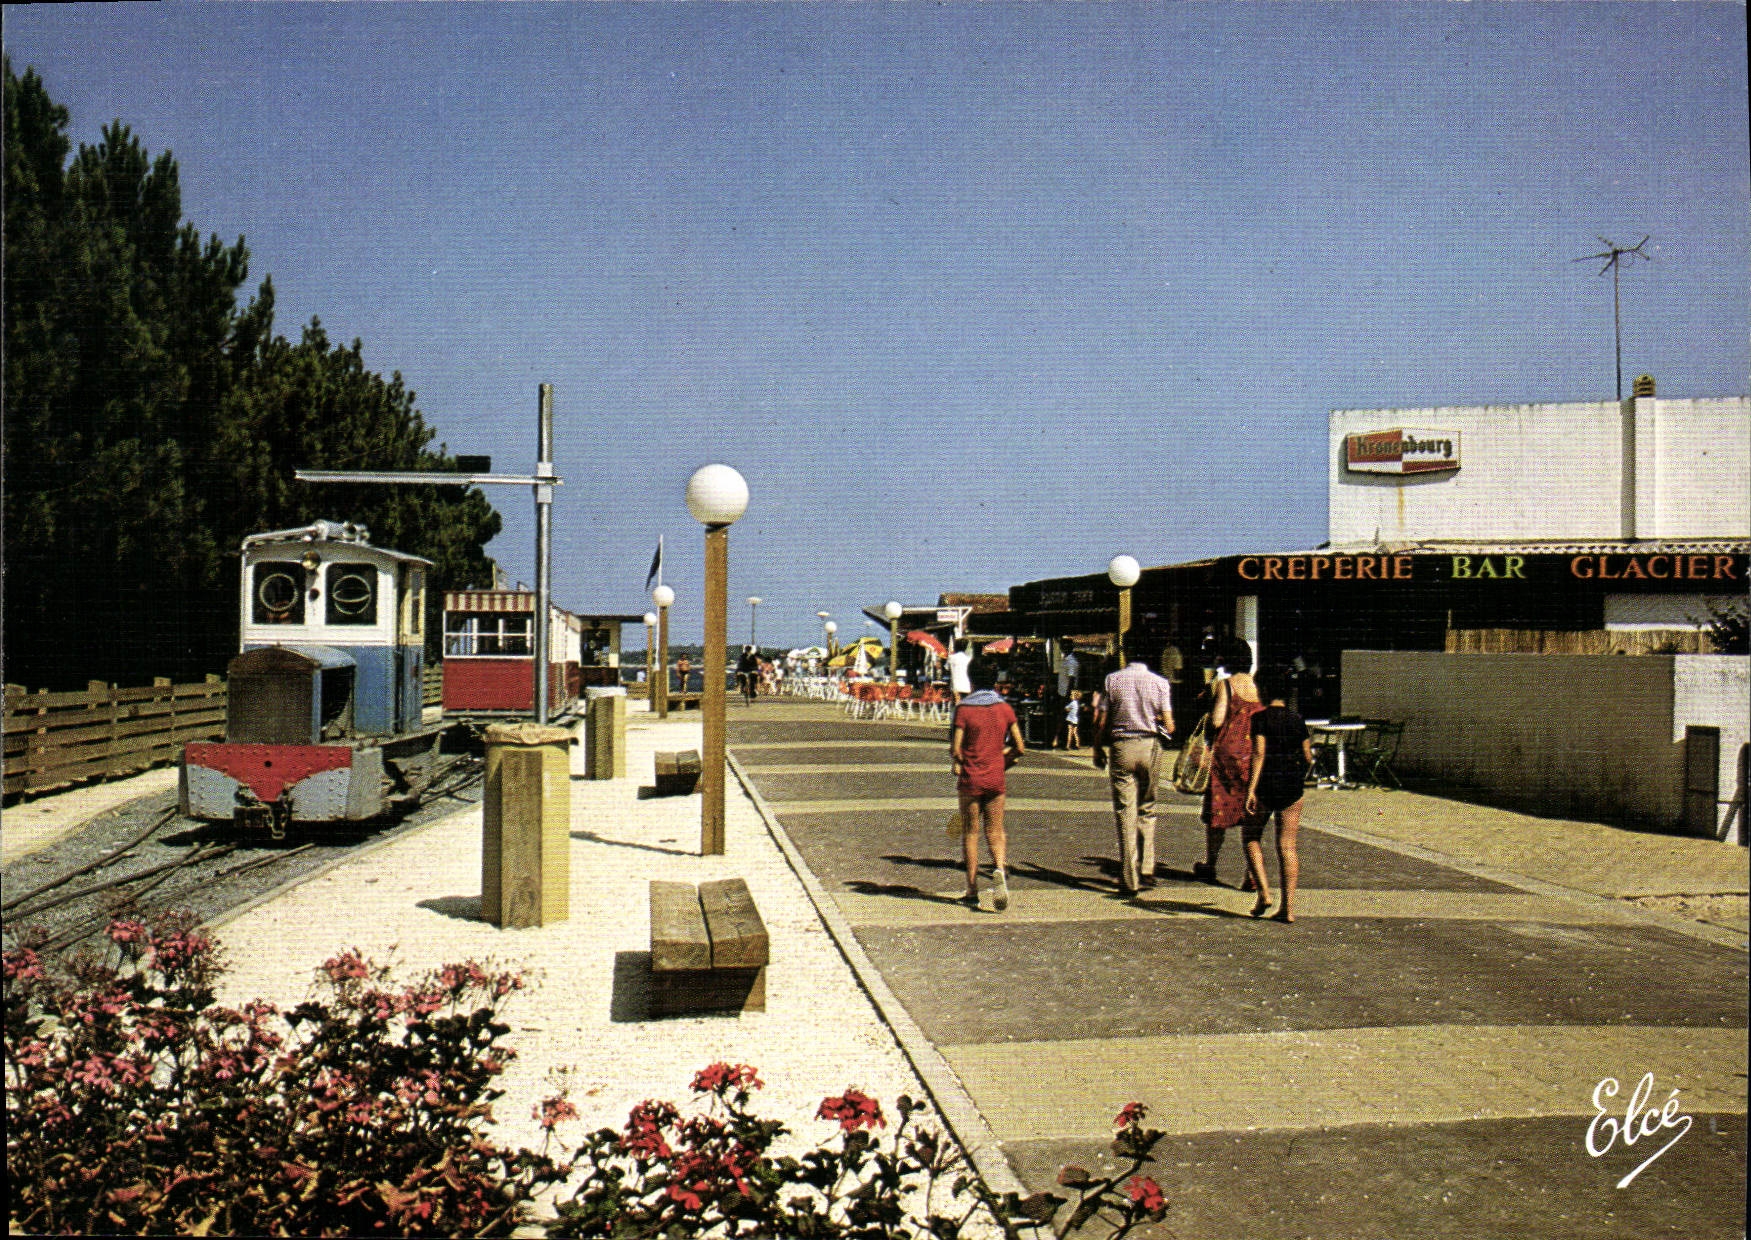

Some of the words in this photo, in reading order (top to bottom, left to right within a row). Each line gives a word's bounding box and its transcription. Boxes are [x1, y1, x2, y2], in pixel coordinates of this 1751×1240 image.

[1237, 555, 1414, 580] CREPERIE
[1451, 555, 1527, 579] BAR
[1570, 555, 1738, 580] GLACIER
